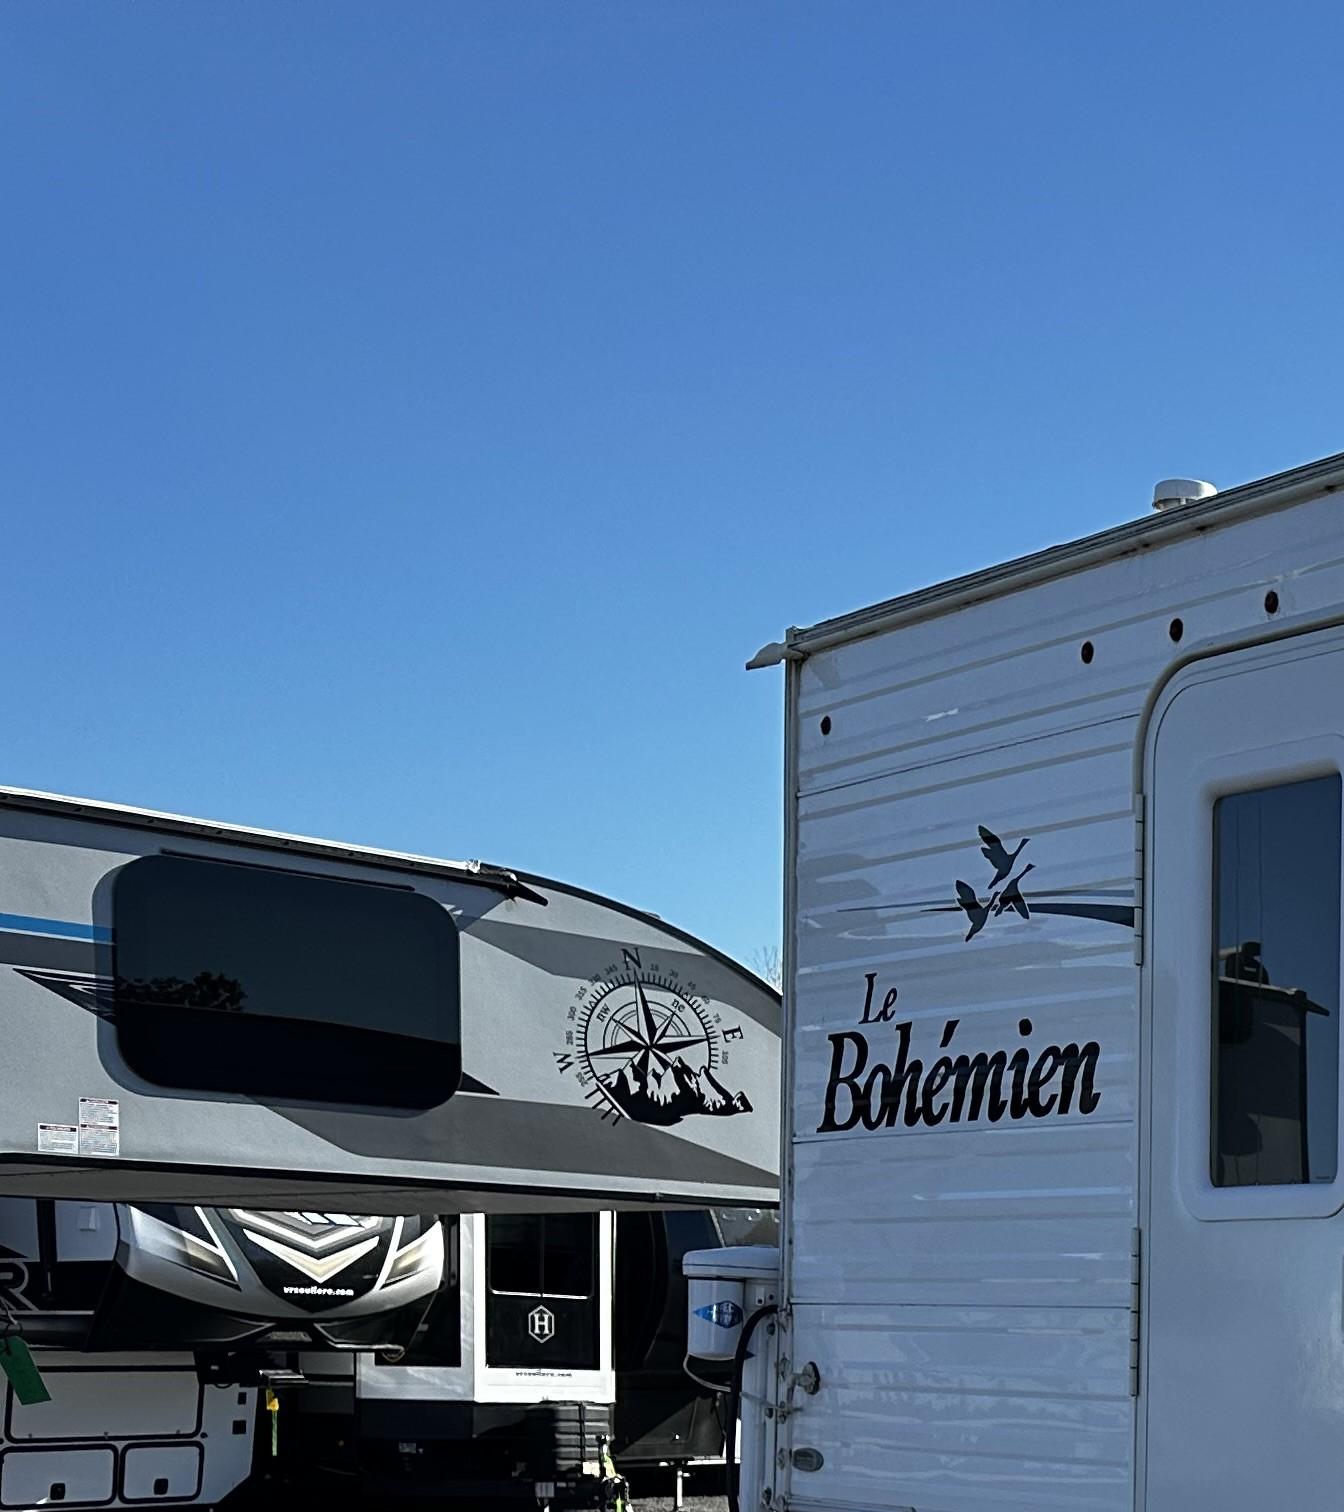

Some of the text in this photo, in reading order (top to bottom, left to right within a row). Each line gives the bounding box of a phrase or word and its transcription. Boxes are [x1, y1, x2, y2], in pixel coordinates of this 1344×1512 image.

[621, 947, 642, 970] N
[858, 972, 898, 1025] Le
[722, 1026, 744, 1044] E
[553, 1052, 574, 1074] W
[816, 1018, 1101, 1134] Bohémien
[534, 1313, 550, 1334] H
